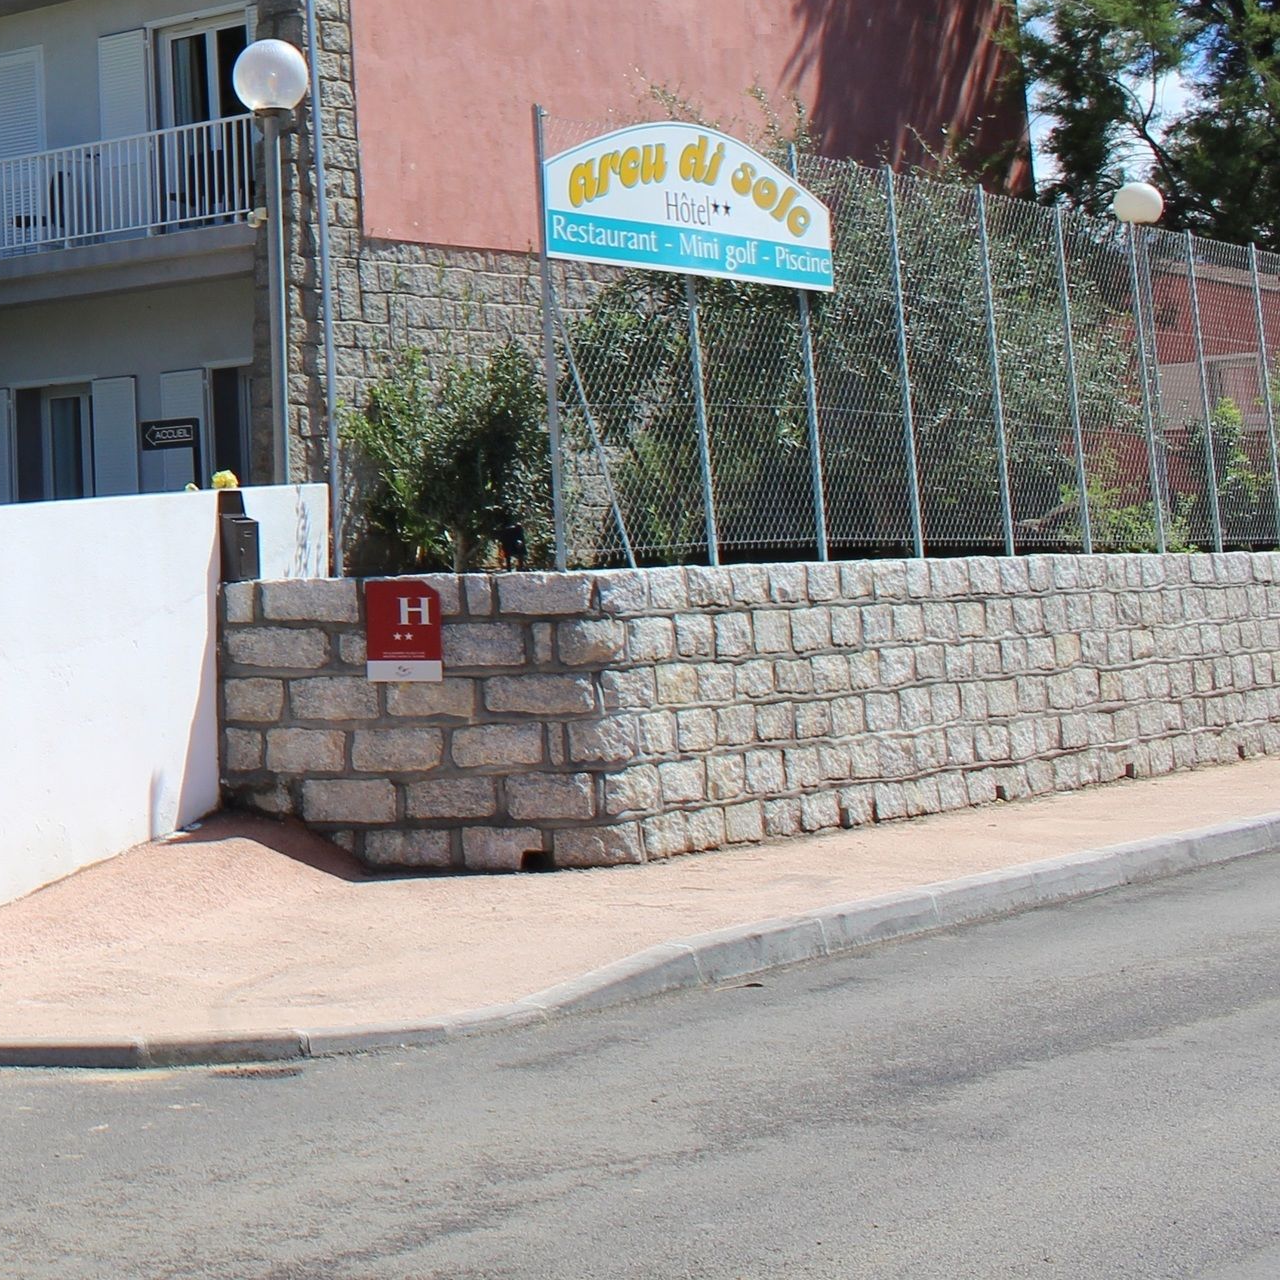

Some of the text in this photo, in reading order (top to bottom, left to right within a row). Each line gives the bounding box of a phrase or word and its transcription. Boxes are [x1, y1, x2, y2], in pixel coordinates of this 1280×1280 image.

[569, 134, 811, 238] arcu di sole
[665, 191, 711, 226] Hôtel
[552, 214, 659, 252] Restaurant
[679, 233, 720, 260] Mini
[725, 240, 758, 271] golf
[775, 245, 831, 274] Piscine
[155, 428, 191, 440] ACCUEIL
[397, 596, 433, 626] H
